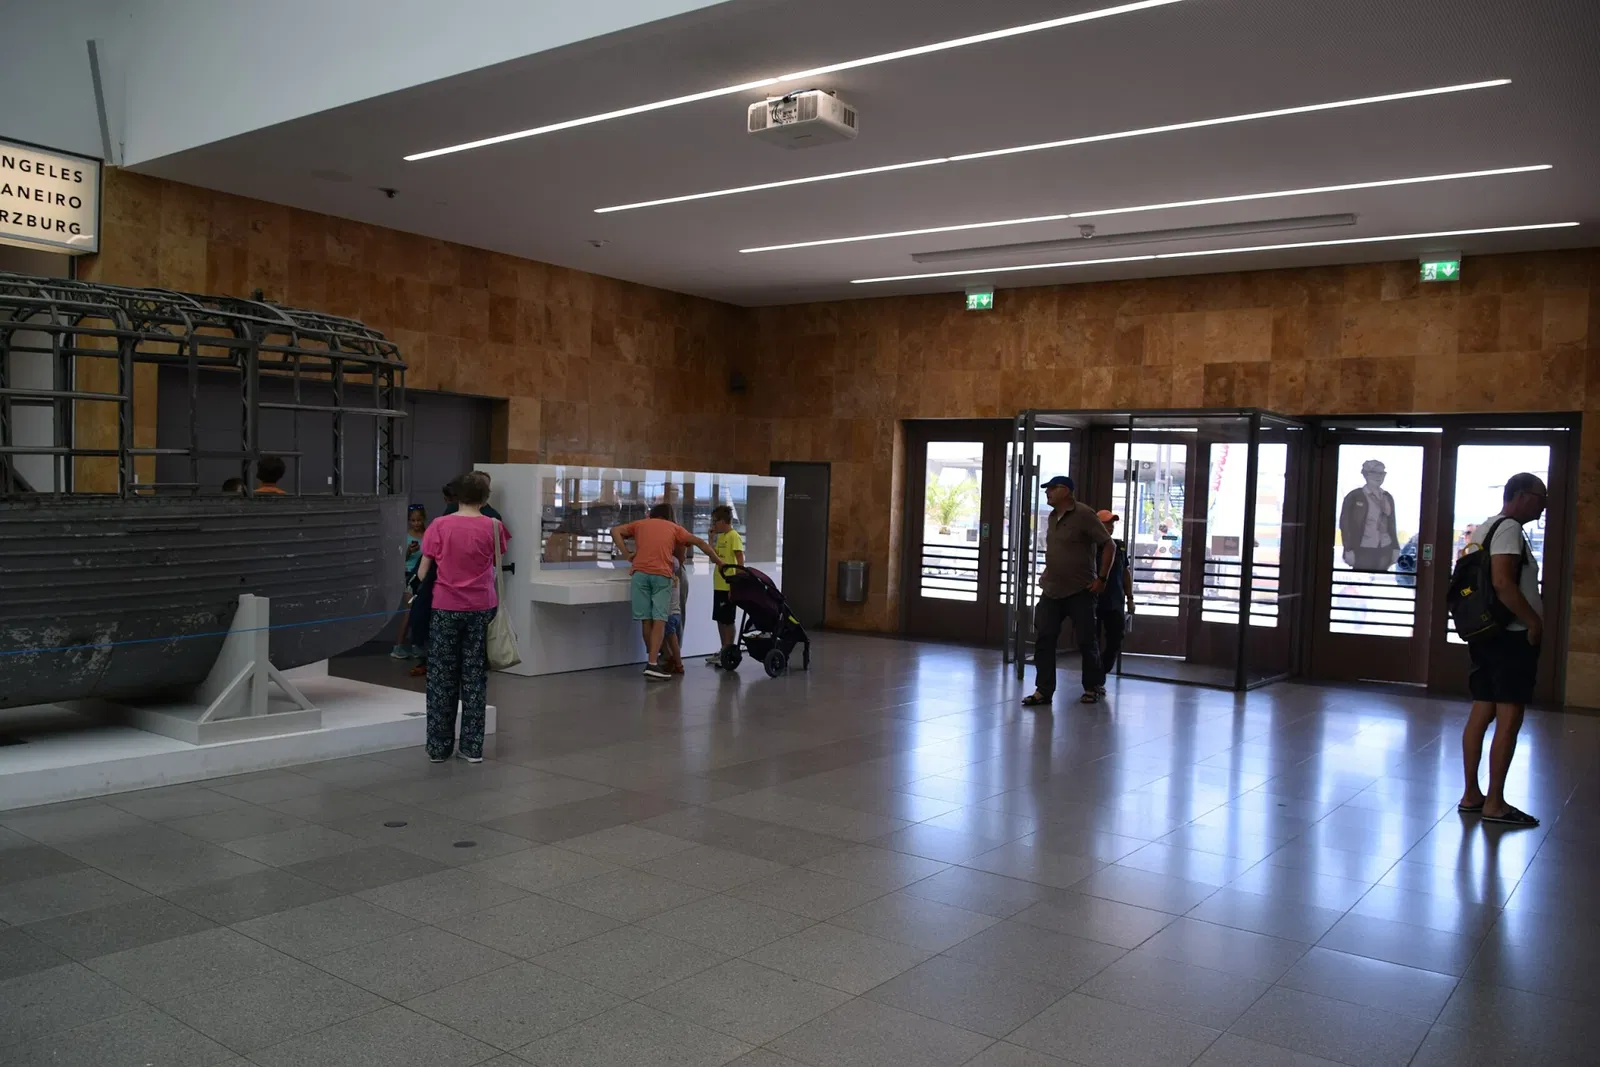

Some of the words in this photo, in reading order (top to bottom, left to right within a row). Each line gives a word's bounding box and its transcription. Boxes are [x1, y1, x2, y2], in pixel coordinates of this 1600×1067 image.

[2, 155, 82, 183] NGELES
[1, 183, 82, 209] ANEIRO
[0, 209, 81, 235] RZBURG
